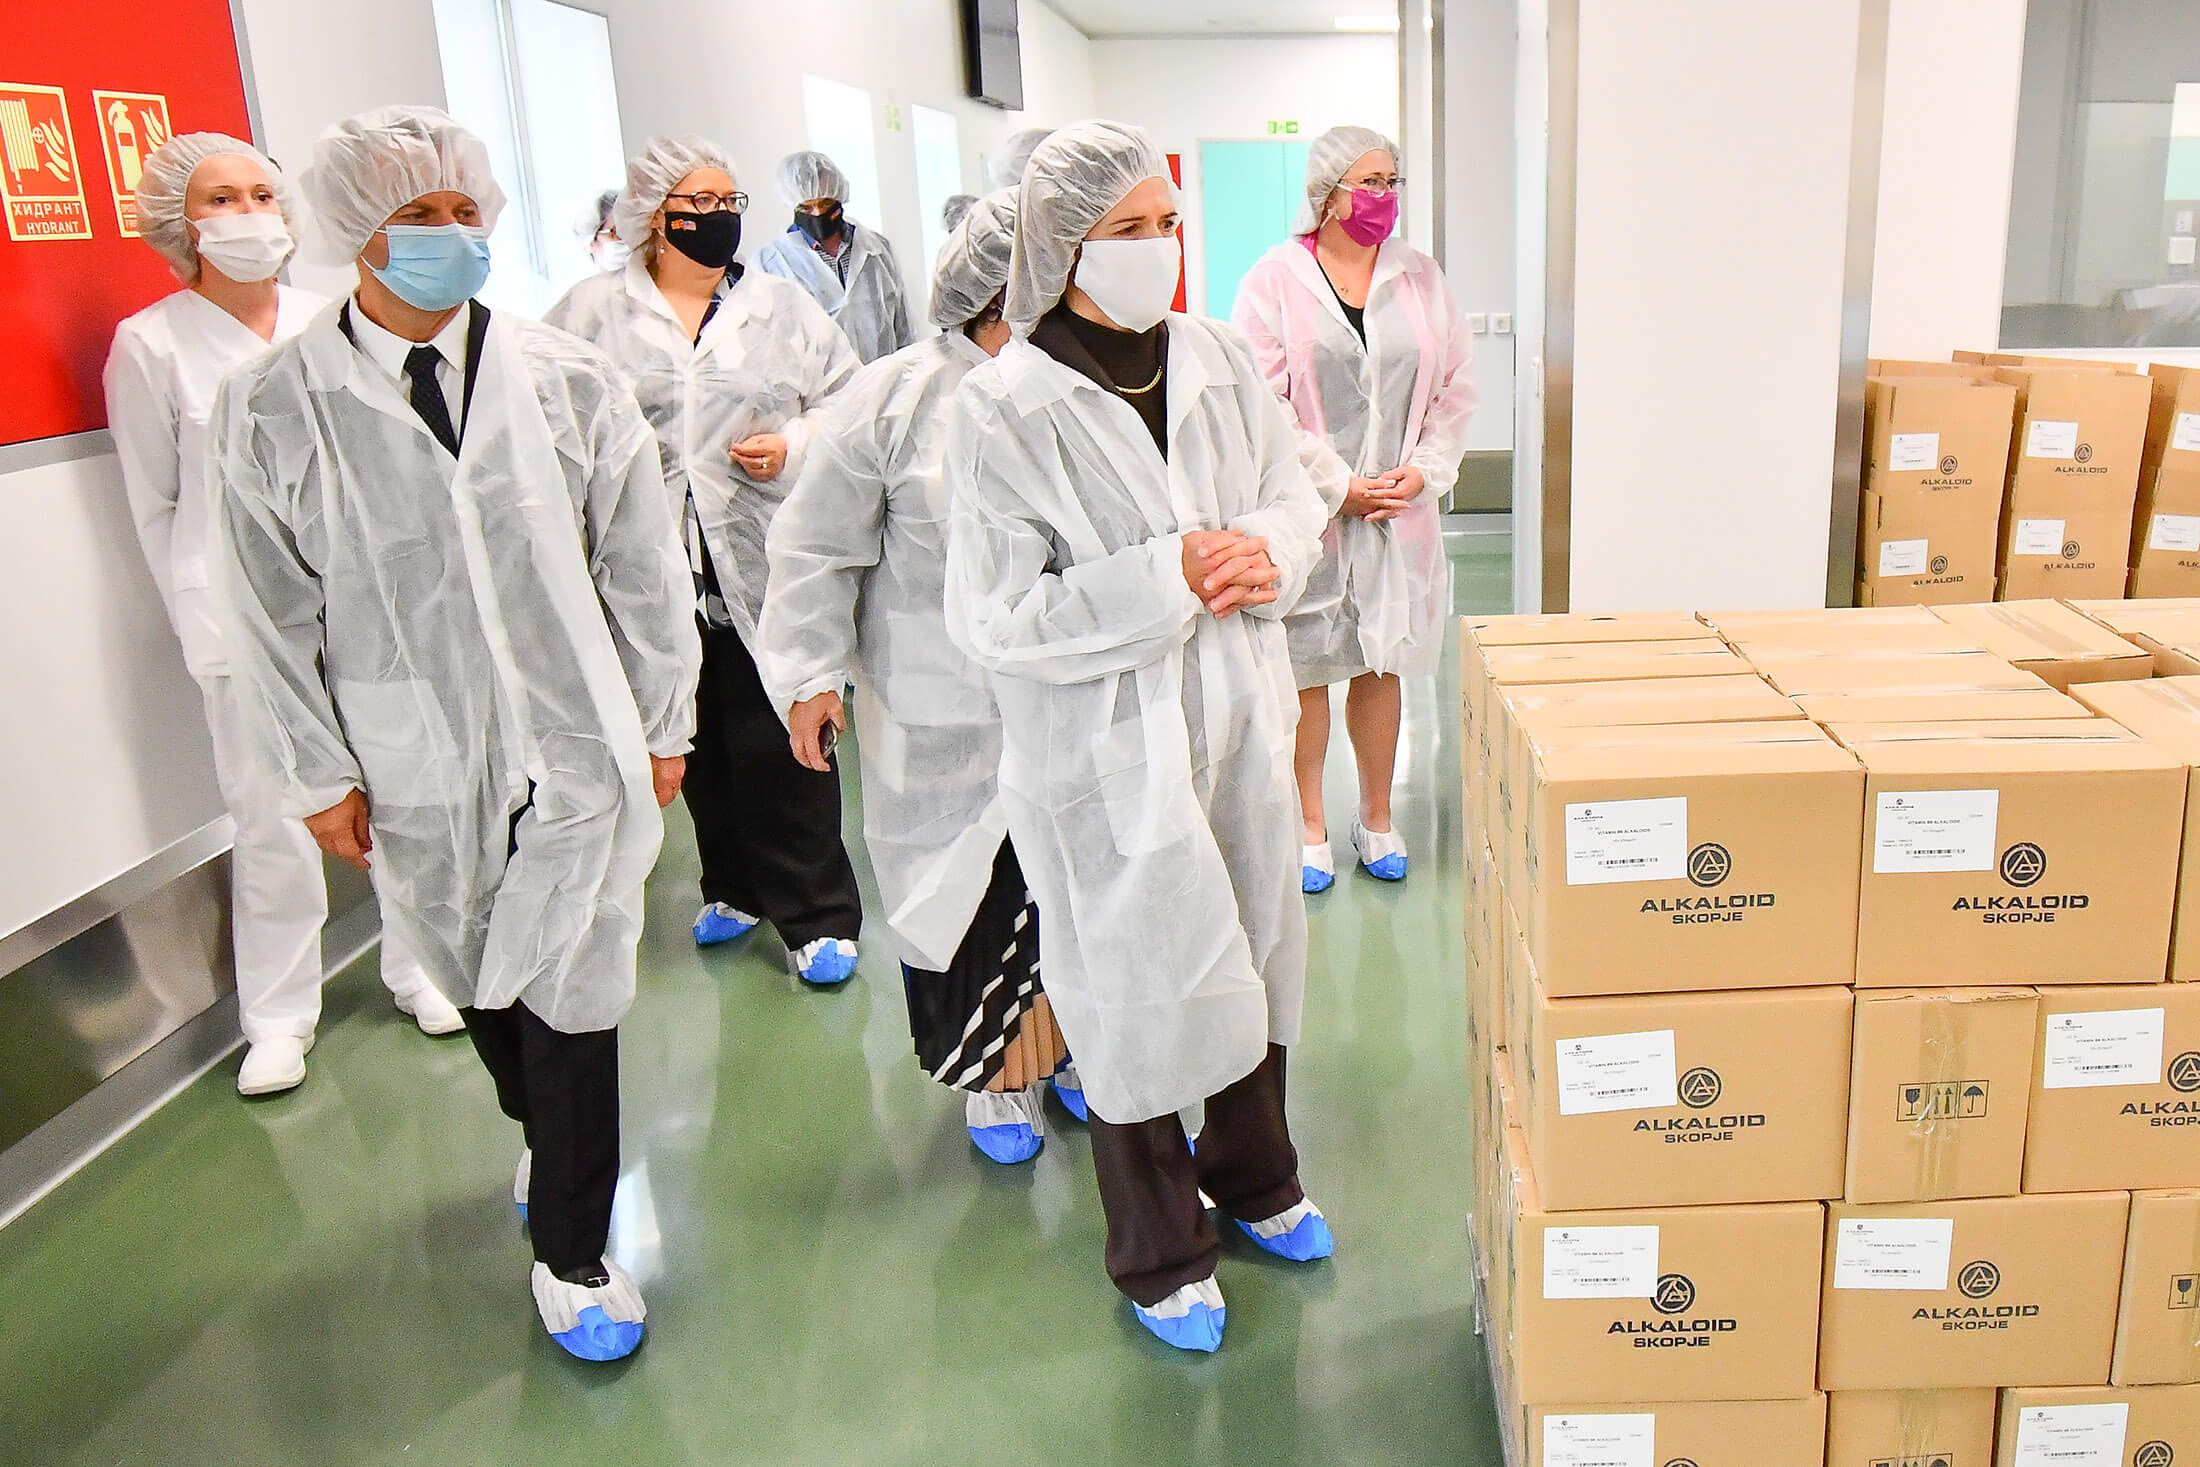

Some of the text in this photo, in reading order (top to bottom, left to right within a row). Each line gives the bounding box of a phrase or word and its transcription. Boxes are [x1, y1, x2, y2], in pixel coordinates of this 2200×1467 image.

[12, 202, 81, 218] ХИДРАНТ
[26, 221, 79, 234] HYDRANT
[1913, 575, 1964, 586] ALKALOID
[1640, 893, 1775, 912] ALKALOID
[1952, 895, 2090, 911] ALKALOID
[1672, 912, 1743, 925] SKOPJE
[1982, 912, 2055, 924] SKOPJE
[1633, 1114, 1765, 1132] ALKALOID
[2150, 1116, 2200, 1127] SKOP
[1664, 1131, 1734, 1144] SKOPJE
[1912, 1304, 2040, 1320] ALKALOID
[1607, 1319, 1737, 1334] ALKALOID
[1942, 1320, 2009, 1331] SKOPJE
[1633, 1336, 1710, 1348] SKOPJE
